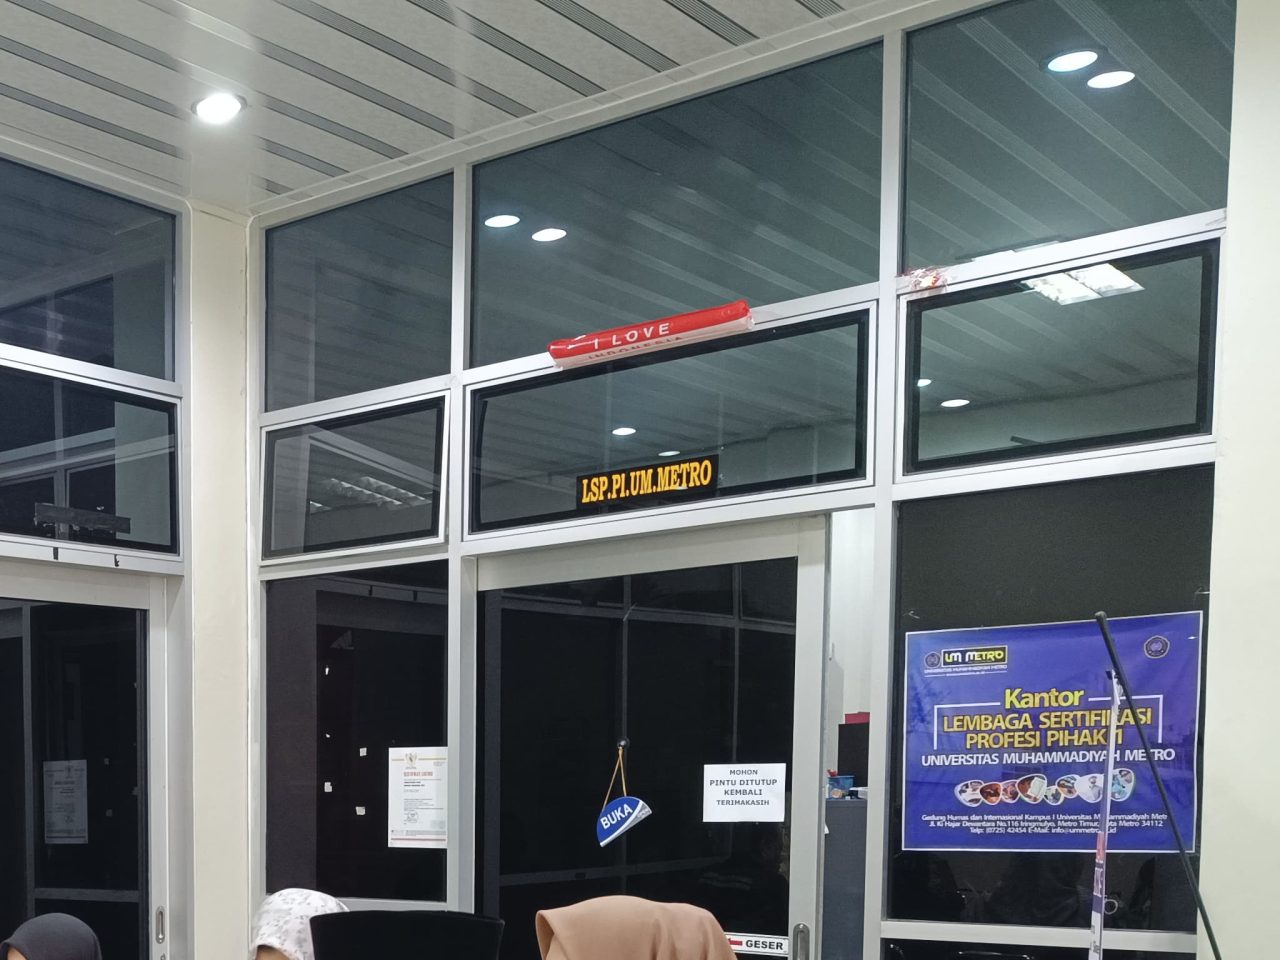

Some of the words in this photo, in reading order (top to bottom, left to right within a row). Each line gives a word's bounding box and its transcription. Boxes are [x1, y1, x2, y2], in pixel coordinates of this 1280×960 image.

[593, 338, 599, 350] I
[612, 322, 670, 346] LOVE
[965, 650, 1004, 662] METRO
[1004, 687, 1085, 710] Kantor
[943, 712, 1034, 732] LEMBAGA
[966, 730, 1041, 749] PROFESI
[1047, 729, 1107, 747] PIHAK
[921, 750, 1000, 767] UNIVERSITAS
[1002, 750, 1120, 765] MUHAMMADIYAH
[739, 778, 778, 786] DITUTUP
[724, 788, 763, 796] KEMBALI
[600, 803, 634, 830] BUKA
[1024, 814, 1051, 822] Kampus
[745, 939, 783, 950] GESER
